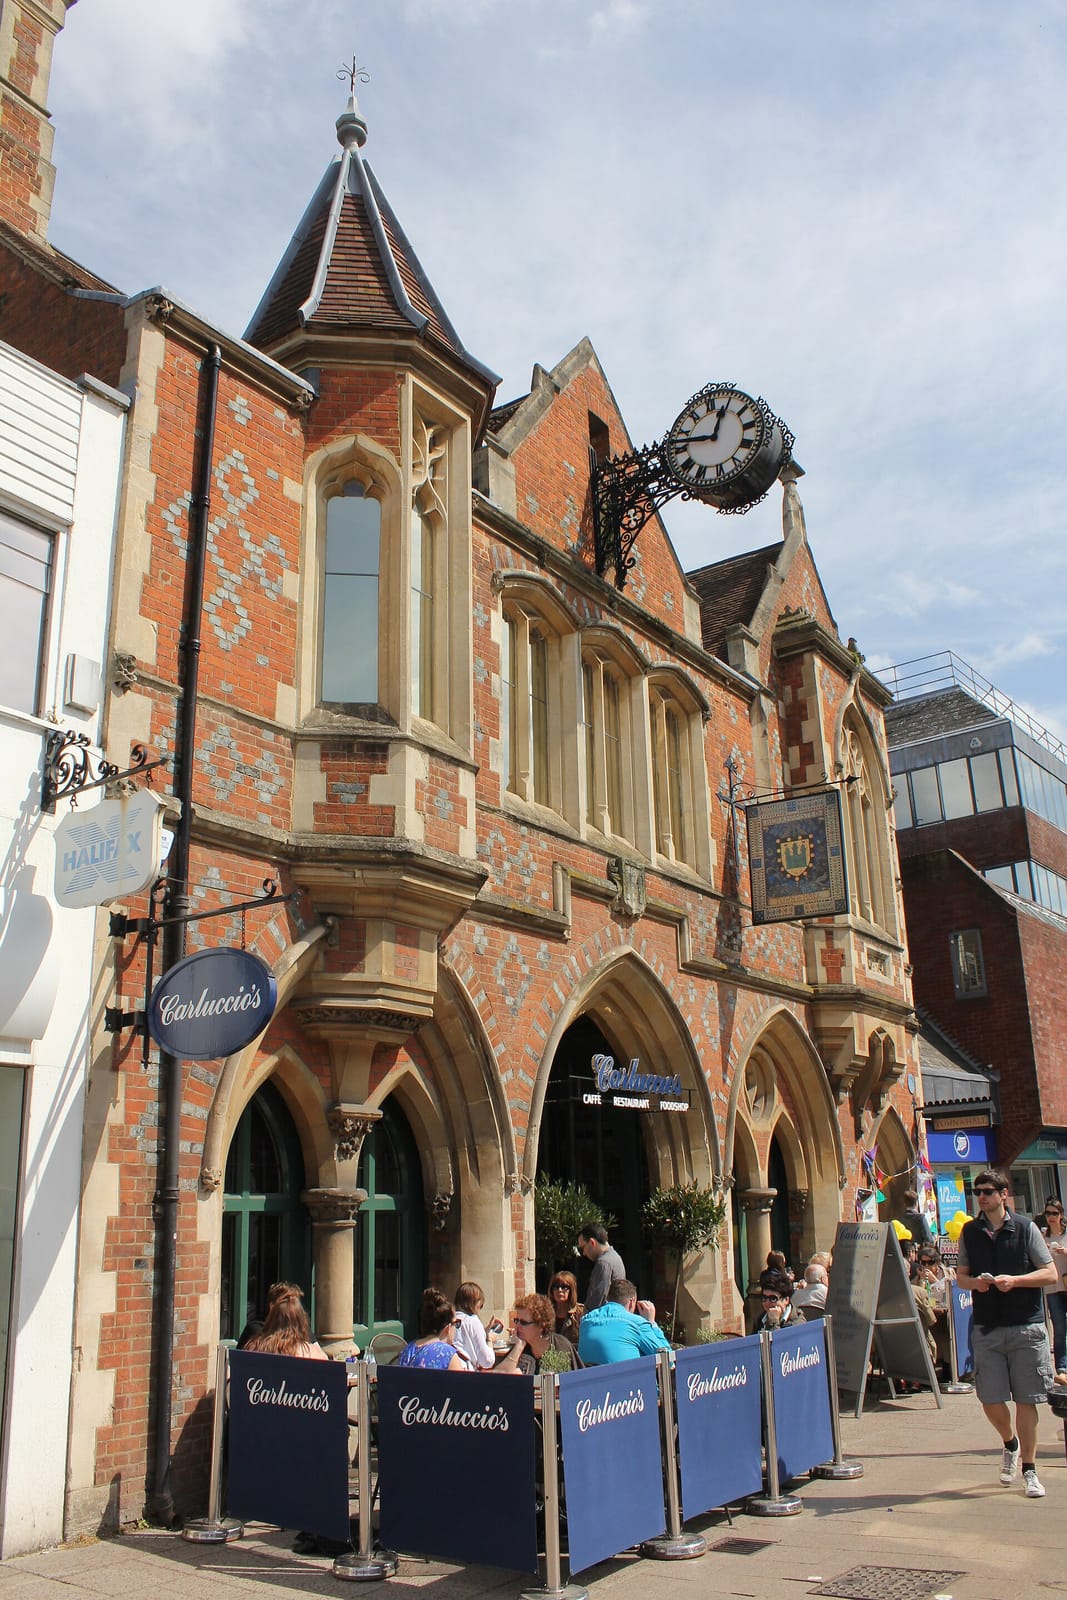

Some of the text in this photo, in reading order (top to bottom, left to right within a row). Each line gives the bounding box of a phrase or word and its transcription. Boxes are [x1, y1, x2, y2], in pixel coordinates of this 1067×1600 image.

[63, 831, 142, 873] HALIFAX
[160, 983, 262, 1026] Carluccio's
[591, 1053, 683, 1096] Carluccio's
[613, 1096, 650, 1109] RESTAURANT
[660, 1100, 690, 1112] FOODSHOP
[839, 1227, 880, 1241] Carluccio's
[780, 1346, 820, 1377] Carluccio's
[246, 1377, 330, 1413] Carluccio's
[687, 1364, 747, 1401] Carluccio's
[398, 1395, 509, 1432] Carluccio's
[576, 1388, 645, 1432] Carluccio's
